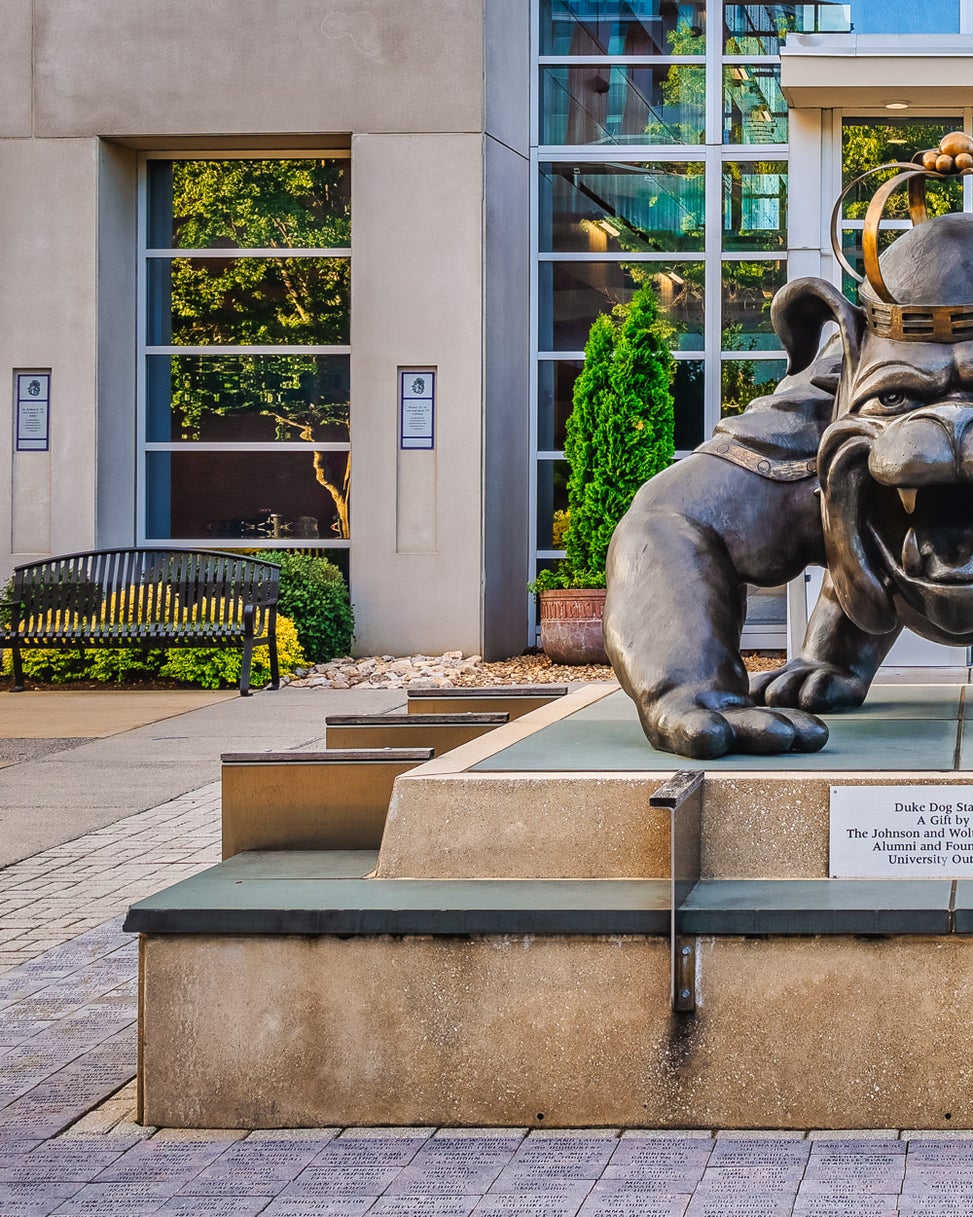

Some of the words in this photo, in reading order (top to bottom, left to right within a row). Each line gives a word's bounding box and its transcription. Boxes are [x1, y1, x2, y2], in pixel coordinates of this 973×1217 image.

[895, 802, 925, 812] Duke
[929, 803, 952, 813] Dog
[917, 816, 925, 825] A
[930, 815, 951, 825] Gift
[955, 815, 969, 826] by
[846, 828, 868, 838] The
[872, 828, 920, 838] Johnson
[924, 828, 945, 838] and
[873, 841, 916, 851] Alumni
[920, 841, 941, 851] and
[888, 854, 947, 866] University
